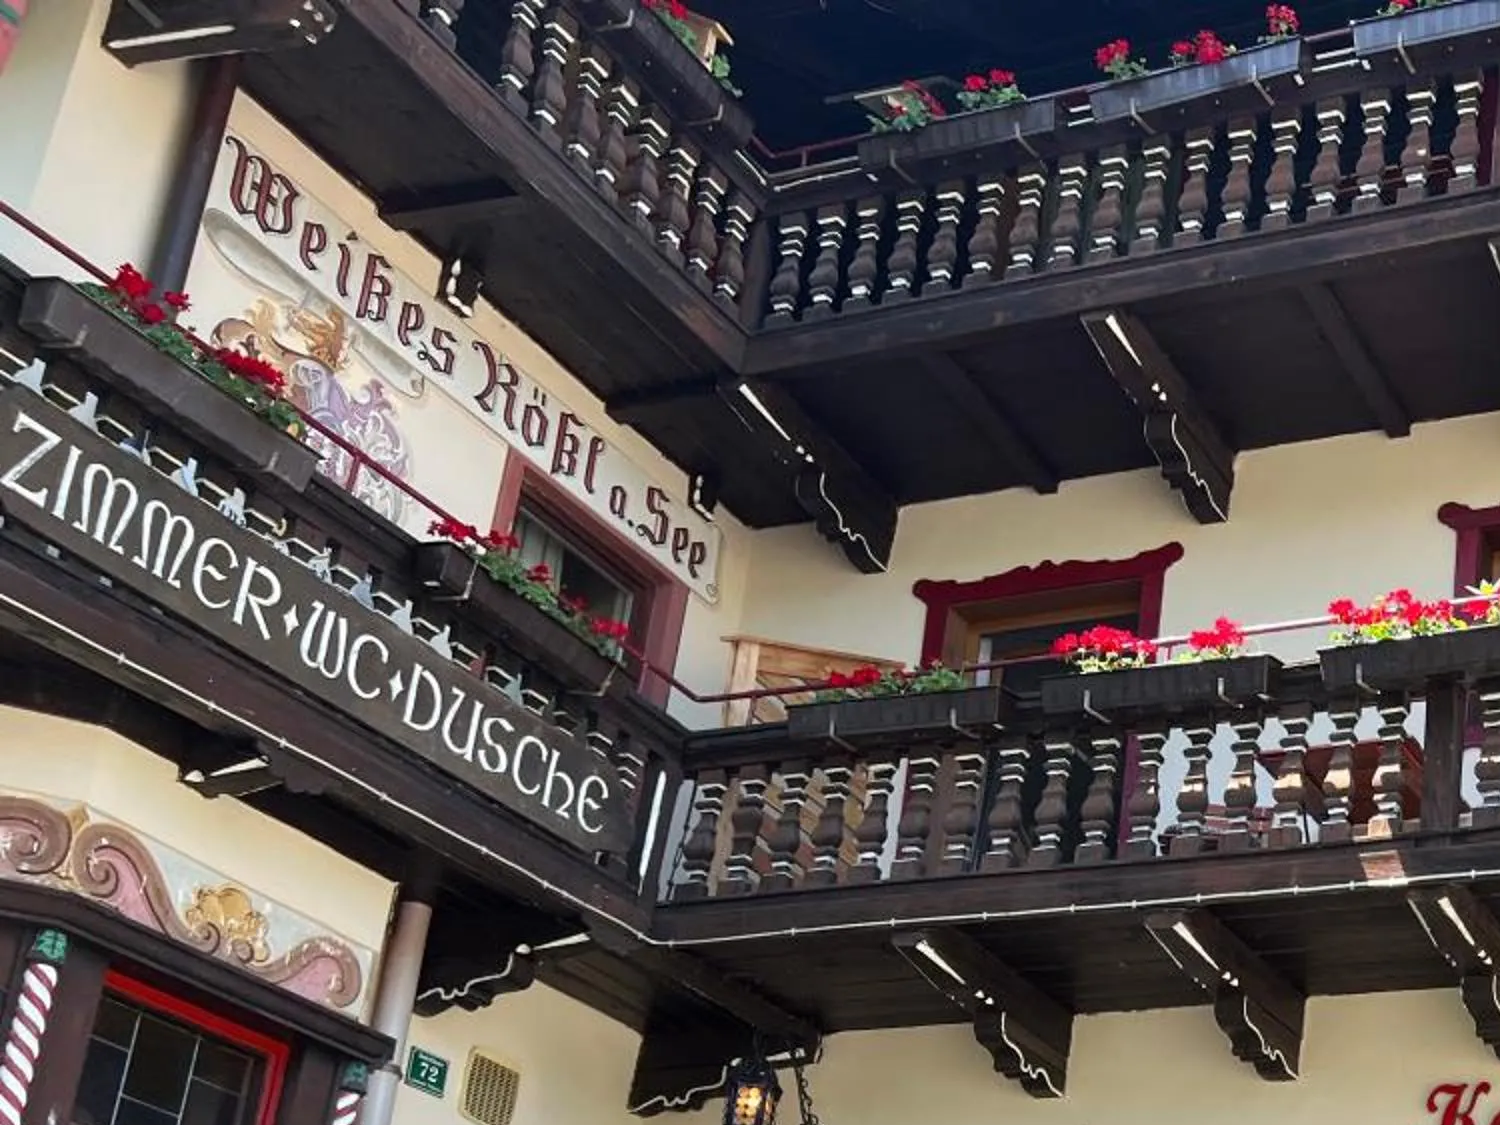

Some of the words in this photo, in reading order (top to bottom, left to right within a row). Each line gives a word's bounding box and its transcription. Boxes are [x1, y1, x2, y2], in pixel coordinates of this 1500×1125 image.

[225, 135, 457, 375] Weißes
[471, 339, 606, 495] Rößl
[0, 410, 282, 641] ZIMMER
[300, 600, 389, 700] WC
[420, 1061, 439, 1083] 72
